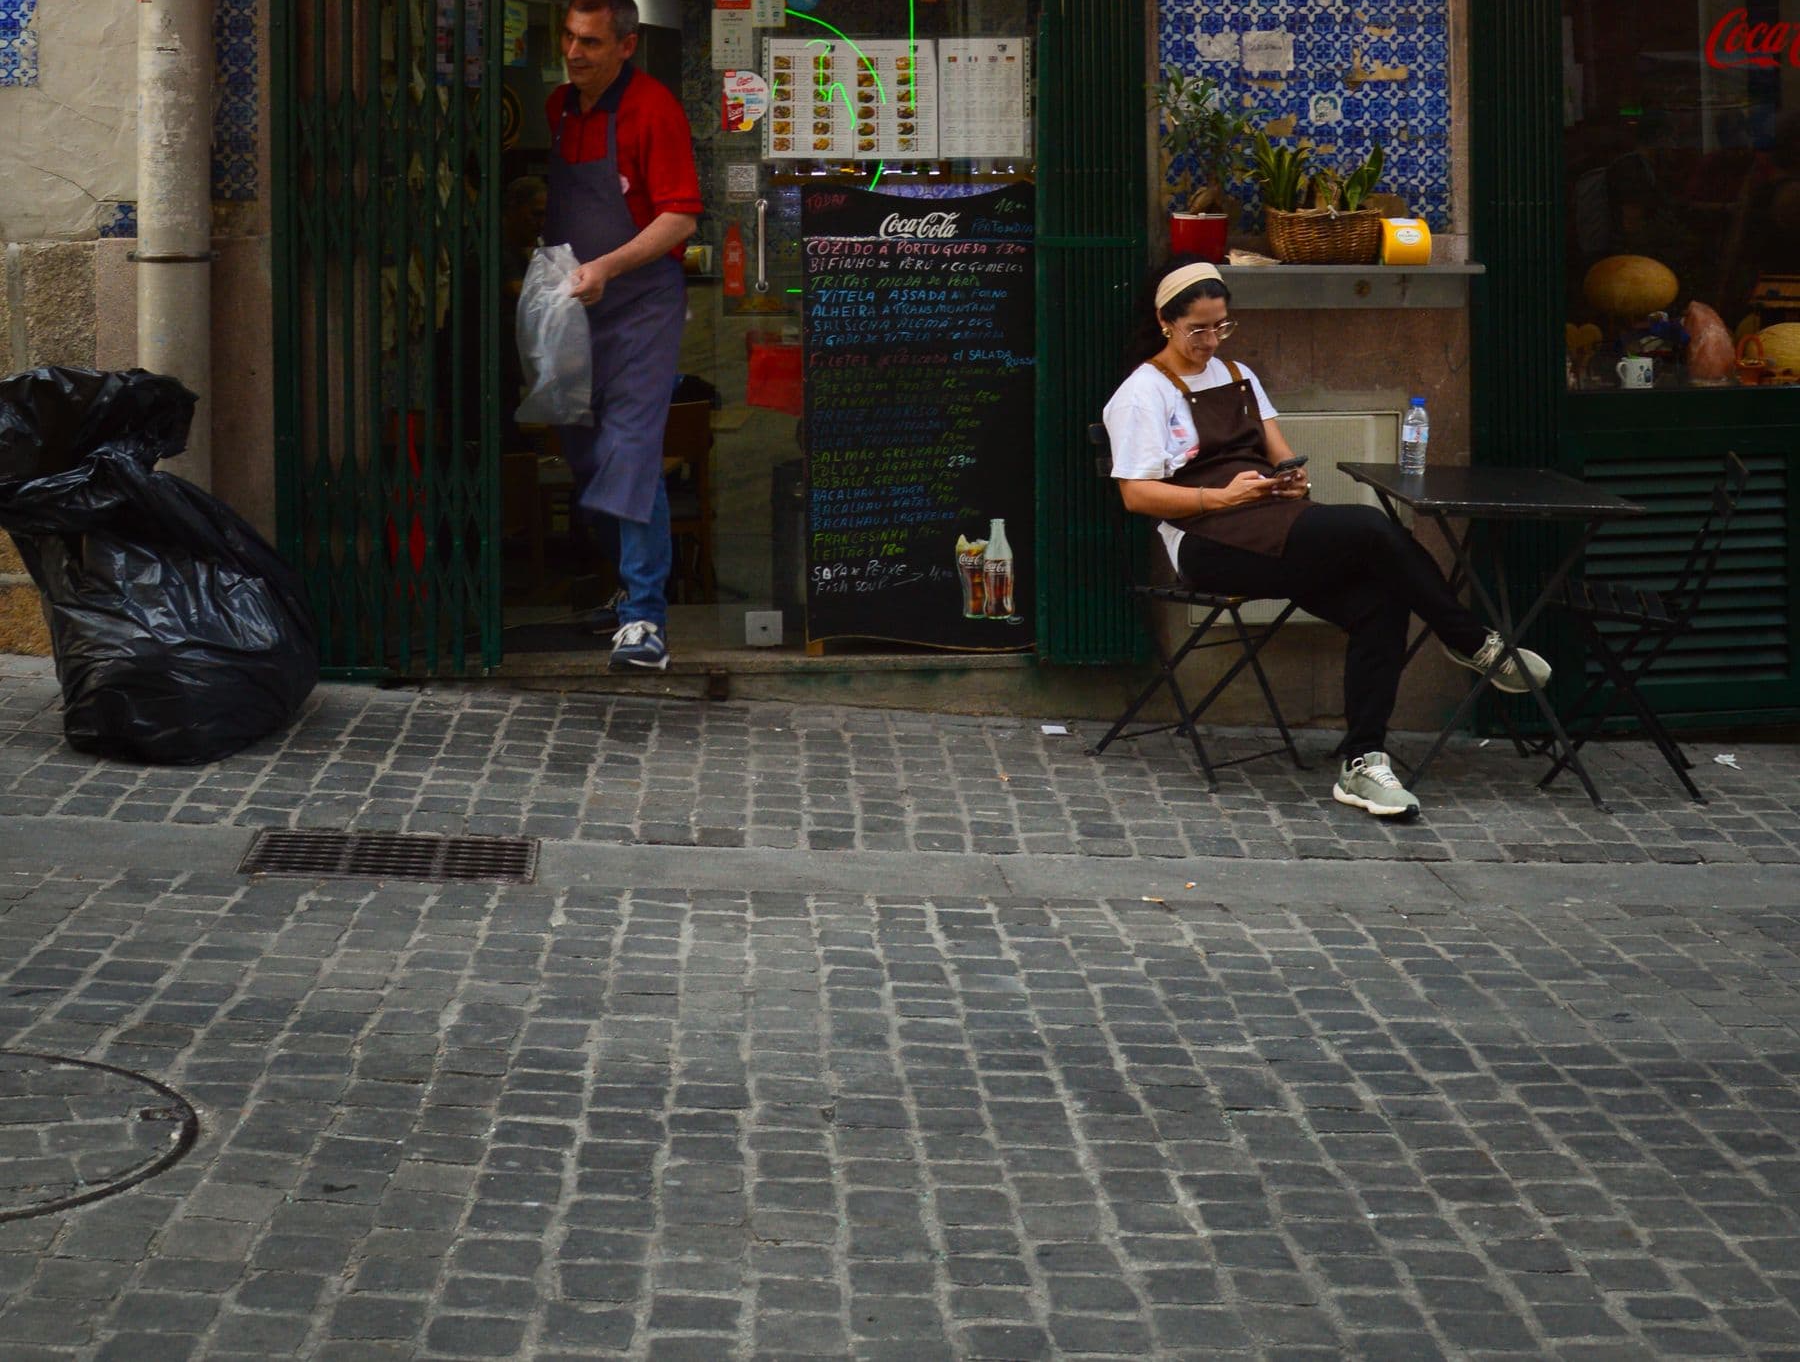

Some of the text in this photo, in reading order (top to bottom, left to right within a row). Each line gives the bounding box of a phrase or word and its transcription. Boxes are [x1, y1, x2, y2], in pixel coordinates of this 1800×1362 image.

[880, 211, 961, 239] Coca-Cola
[806, 241, 875, 256] COZIDO
[896, 240, 988, 257] PORTUGUESA
[888, 289, 946, 302] ASSADA
[811, 303, 877, 318] ALHEIRA
